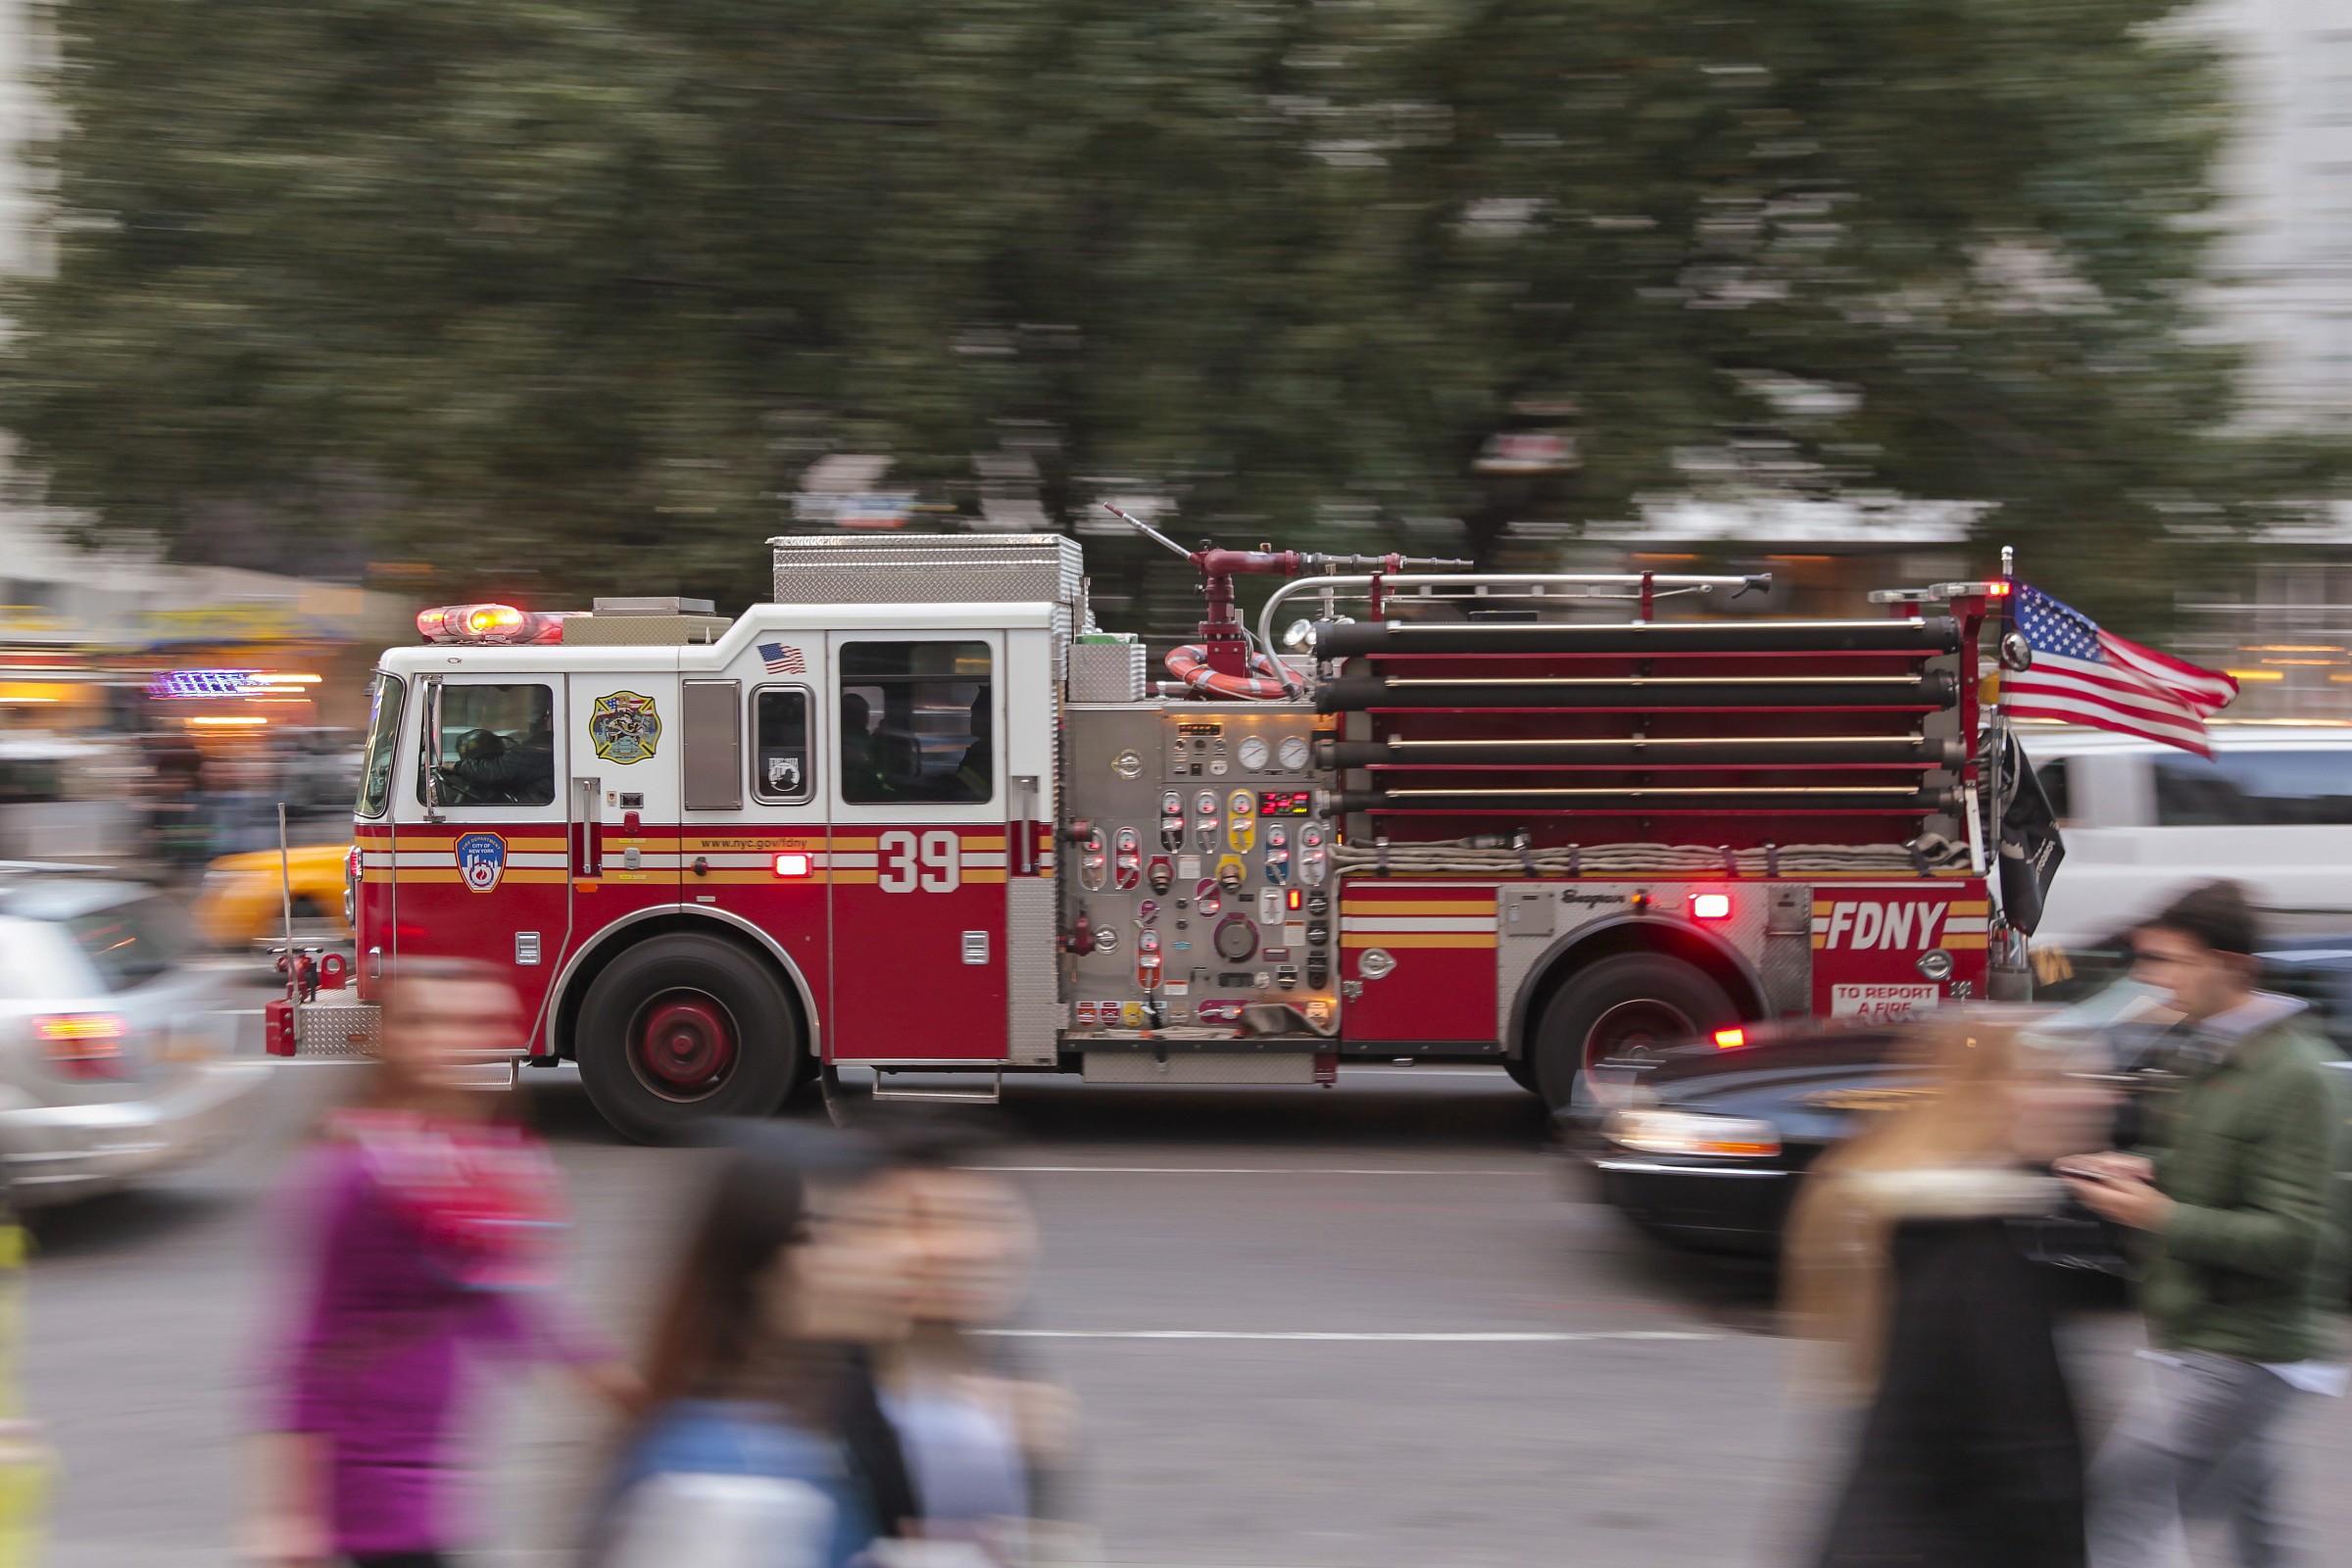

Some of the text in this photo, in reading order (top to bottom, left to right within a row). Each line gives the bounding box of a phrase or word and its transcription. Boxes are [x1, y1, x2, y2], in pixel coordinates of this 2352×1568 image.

[462, 836, 501, 850] FIRE DEPARTMENT
[701, 838, 808, 850] www.nyc.gov/fdny
[879, 831, 960, 894] 39
[1826, 901, 1947, 951] FDNY
[1838, 987, 1934, 999] TO REPORT
[1857, 1003, 1869, 1015] A
